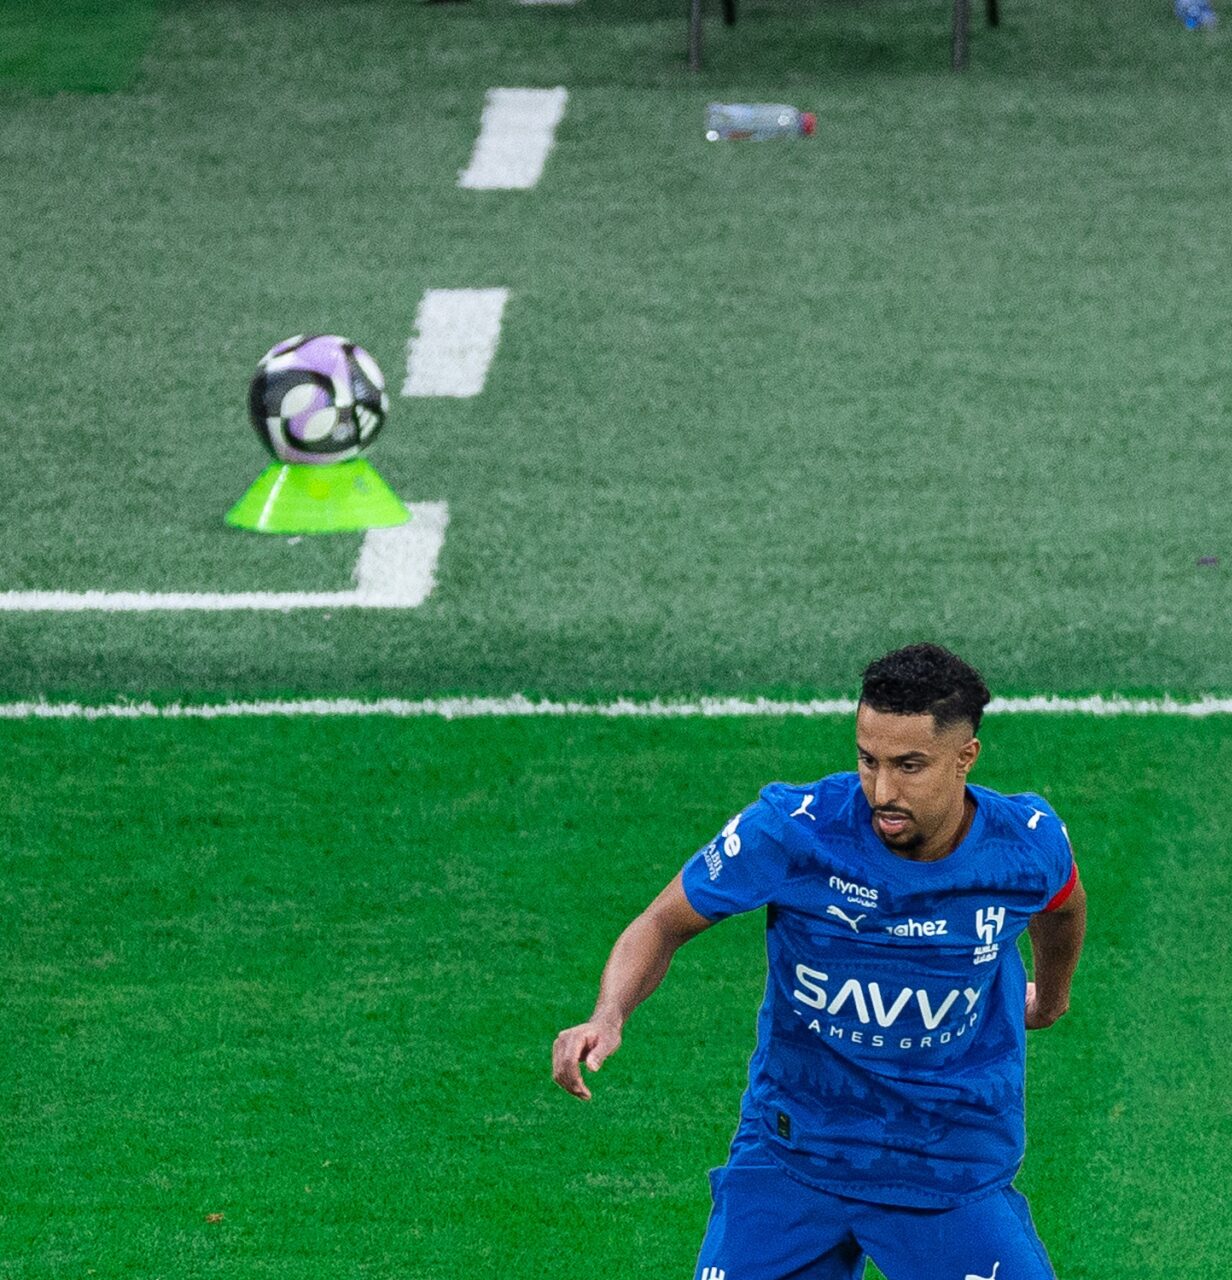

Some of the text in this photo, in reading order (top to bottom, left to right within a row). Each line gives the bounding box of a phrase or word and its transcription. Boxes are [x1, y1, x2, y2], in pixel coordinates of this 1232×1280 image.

[829, 876, 878, 900] flynas
[794, 964, 981, 1030] SAVVY
[794, 1010, 977, 1049] AMES GROUP
